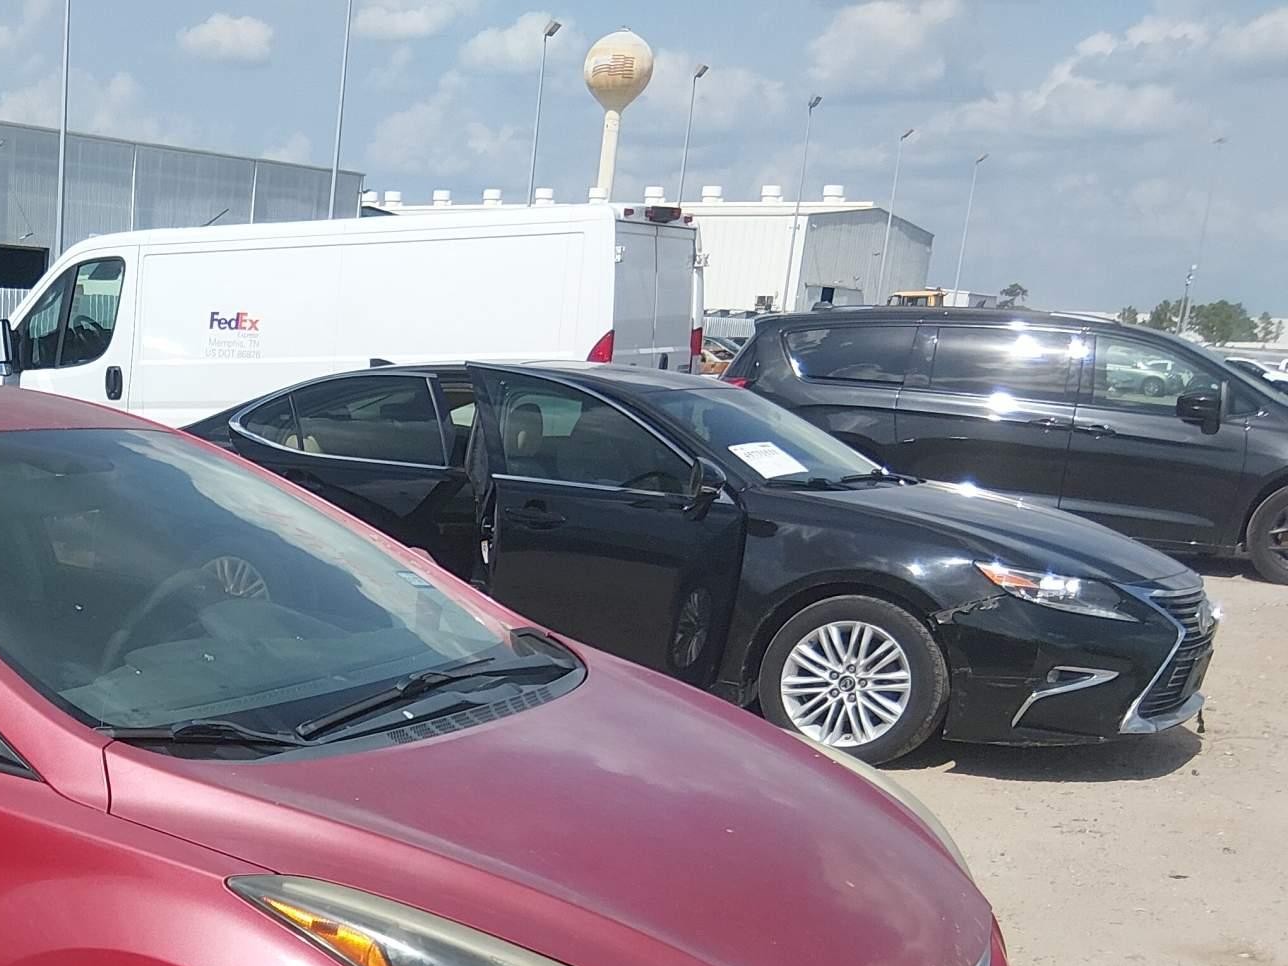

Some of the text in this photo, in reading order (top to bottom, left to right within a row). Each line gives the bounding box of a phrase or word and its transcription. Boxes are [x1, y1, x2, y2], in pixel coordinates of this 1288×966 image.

[209, 311, 260, 331] FedEx
[248, 339, 261, 348] TN
[218, 349, 235, 359] DOT
